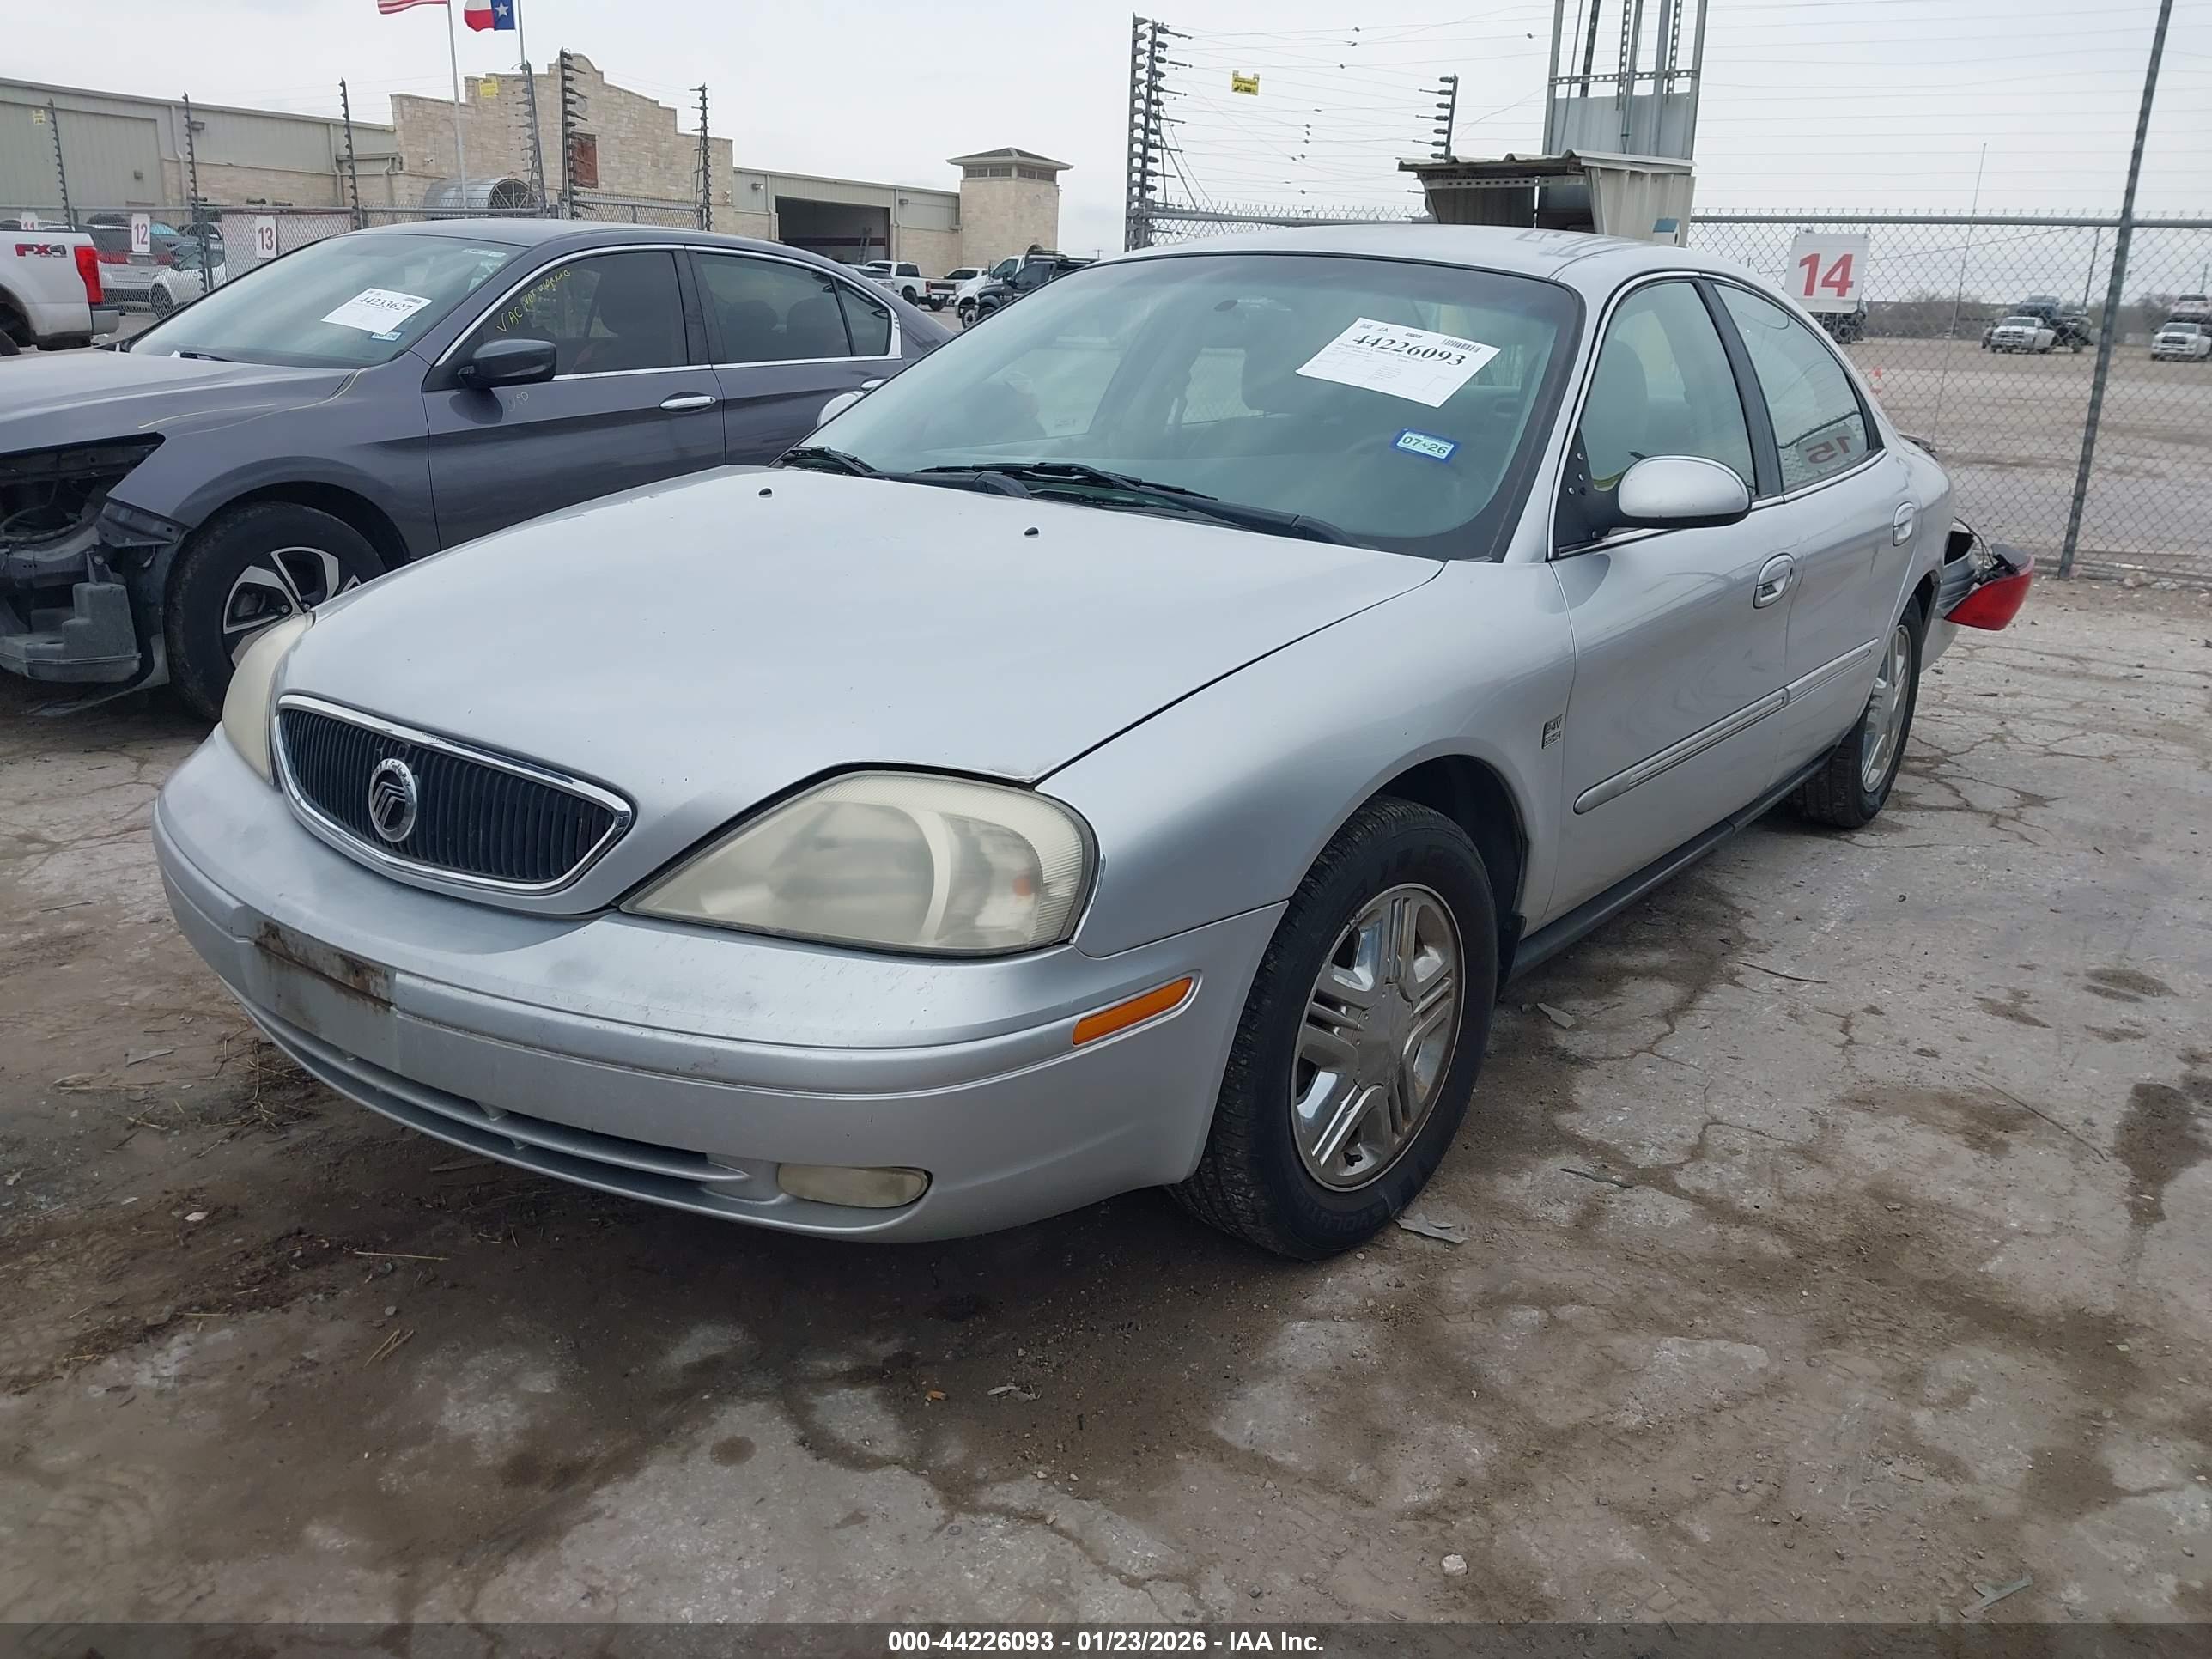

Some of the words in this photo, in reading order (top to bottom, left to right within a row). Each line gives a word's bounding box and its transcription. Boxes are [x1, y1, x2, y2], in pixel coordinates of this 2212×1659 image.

[134, 223, 148, 245] 12
[258, 226, 274, 250] 13
[15, 244, 66, 257] FX4
[1799, 252, 1855, 297] 14
[360, 296, 413, 312] 44233627
[1352, 334, 1467, 367] 44226093
